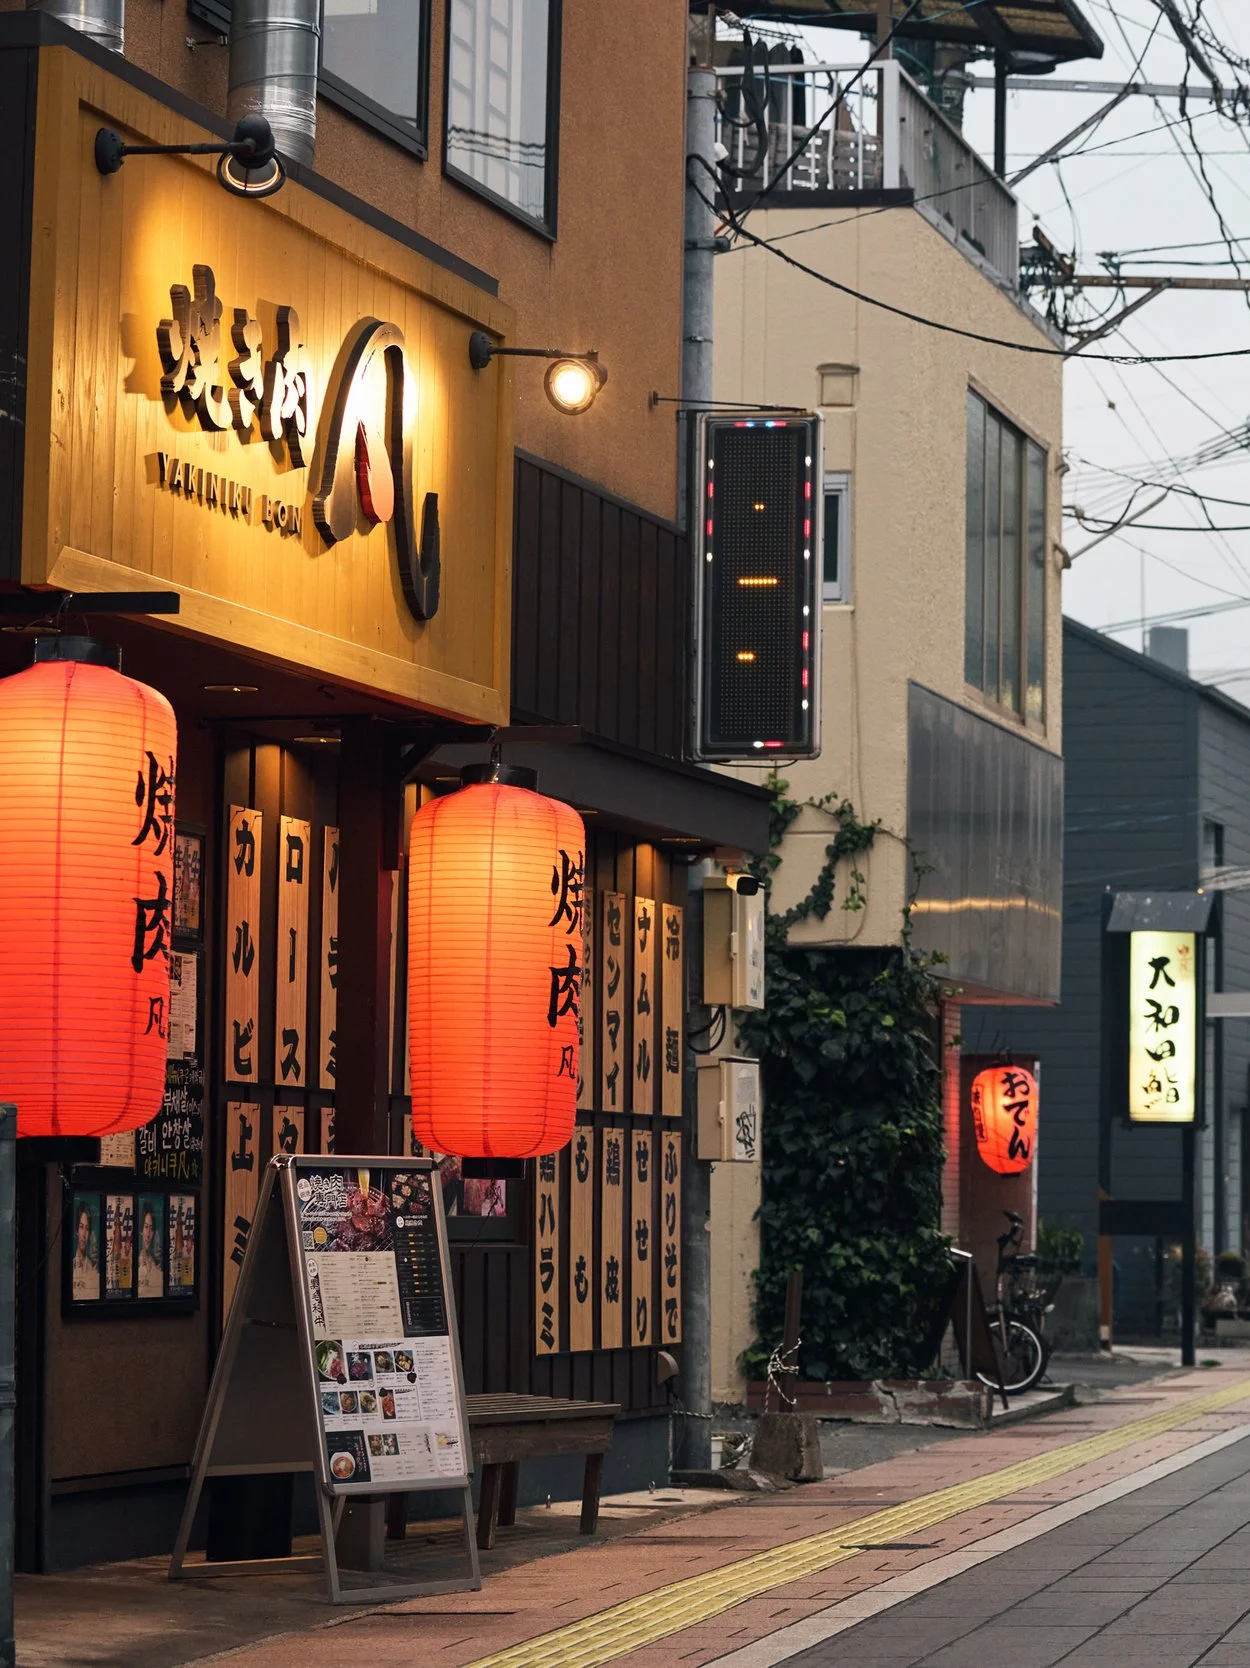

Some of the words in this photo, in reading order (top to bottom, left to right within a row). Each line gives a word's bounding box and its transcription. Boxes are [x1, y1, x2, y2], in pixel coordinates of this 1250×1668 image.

[158, 451, 252, 517] YAKINIKU
[262, 494, 302, 536] BON
[233, 818, 257, 1076] カルビ
[279, 833, 304, 1082] ロース
[606, 900, 621, 1106] センマイ
[637, 907, 650, 1082] ナムル
[1001, 1071, 1030, 1160] おでん
[574, 1134, 590, 1304] もも
[635, 1140, 649, 1342] せせり
[664, 1140, 678, 1340] ふりそで
